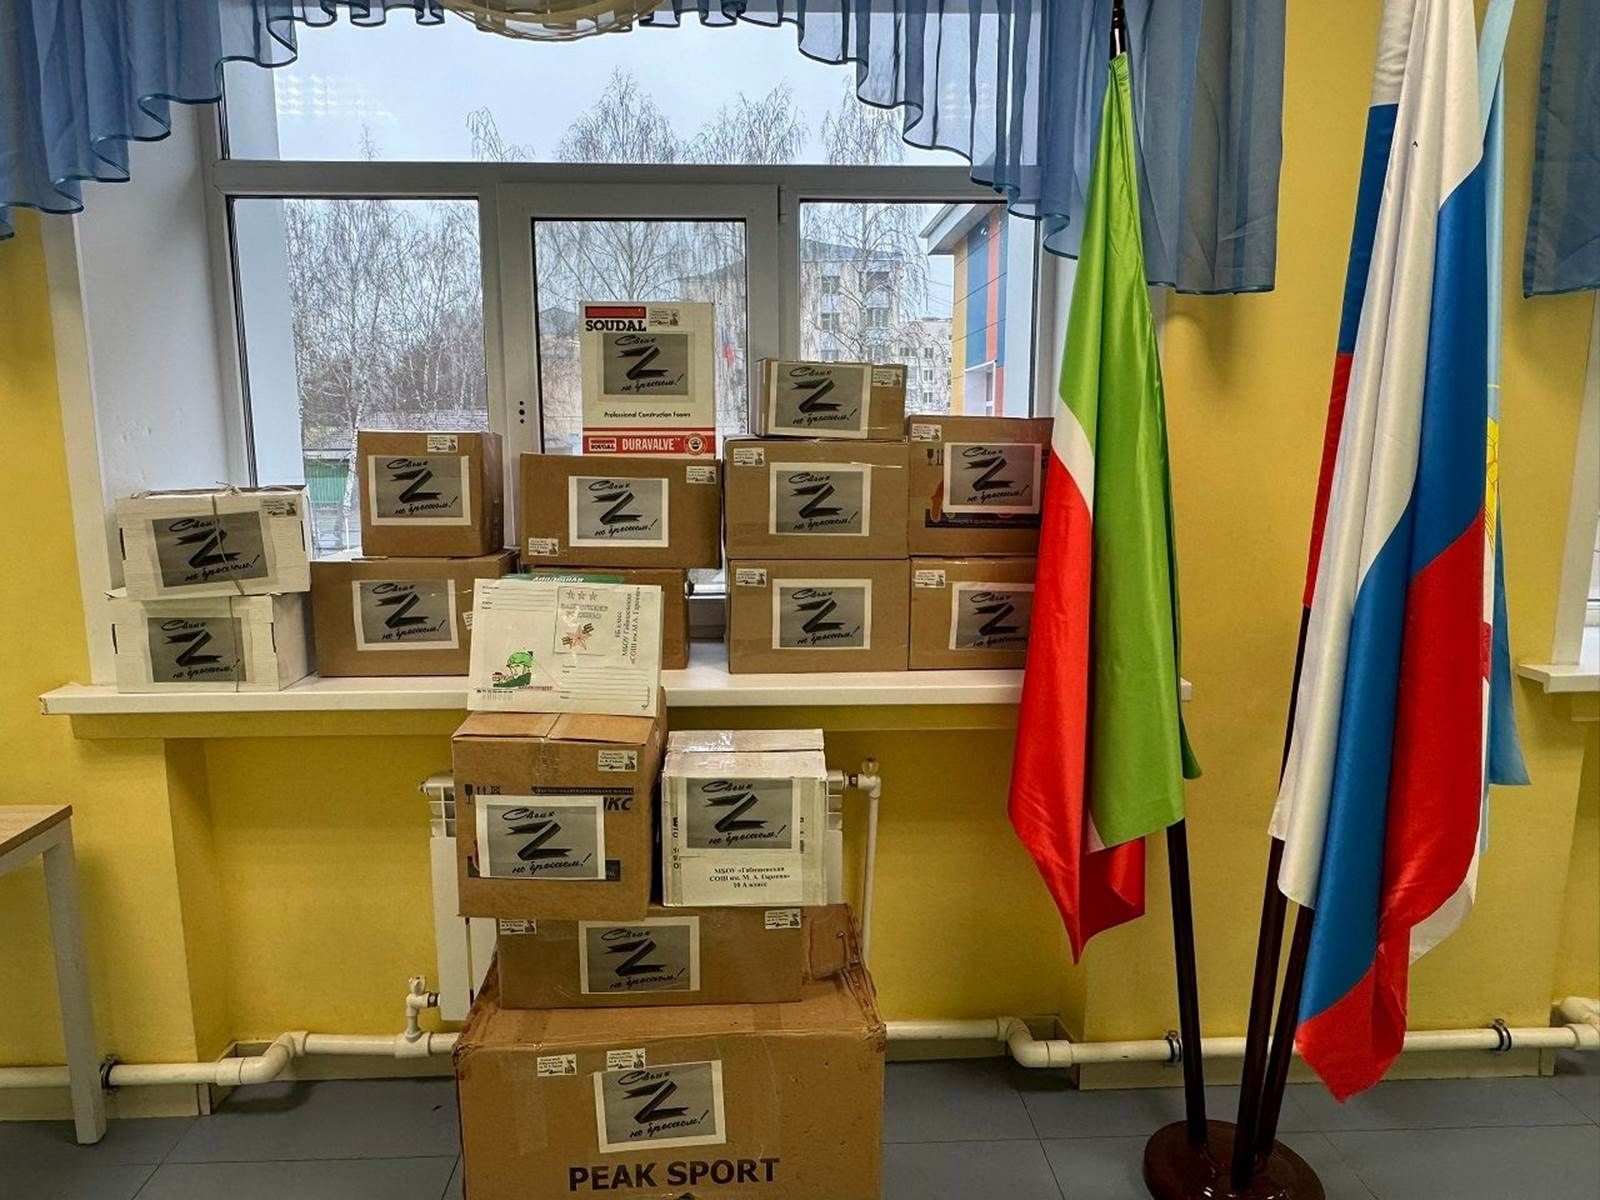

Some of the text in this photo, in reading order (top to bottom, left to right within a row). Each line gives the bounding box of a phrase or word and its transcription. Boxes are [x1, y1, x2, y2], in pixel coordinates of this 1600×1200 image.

[585, 320, 646, 331] SOUDAL
[622, 438, 675, 451] DURAVALVE
[569, 1158, 780, 1191] PEAK SPORT
